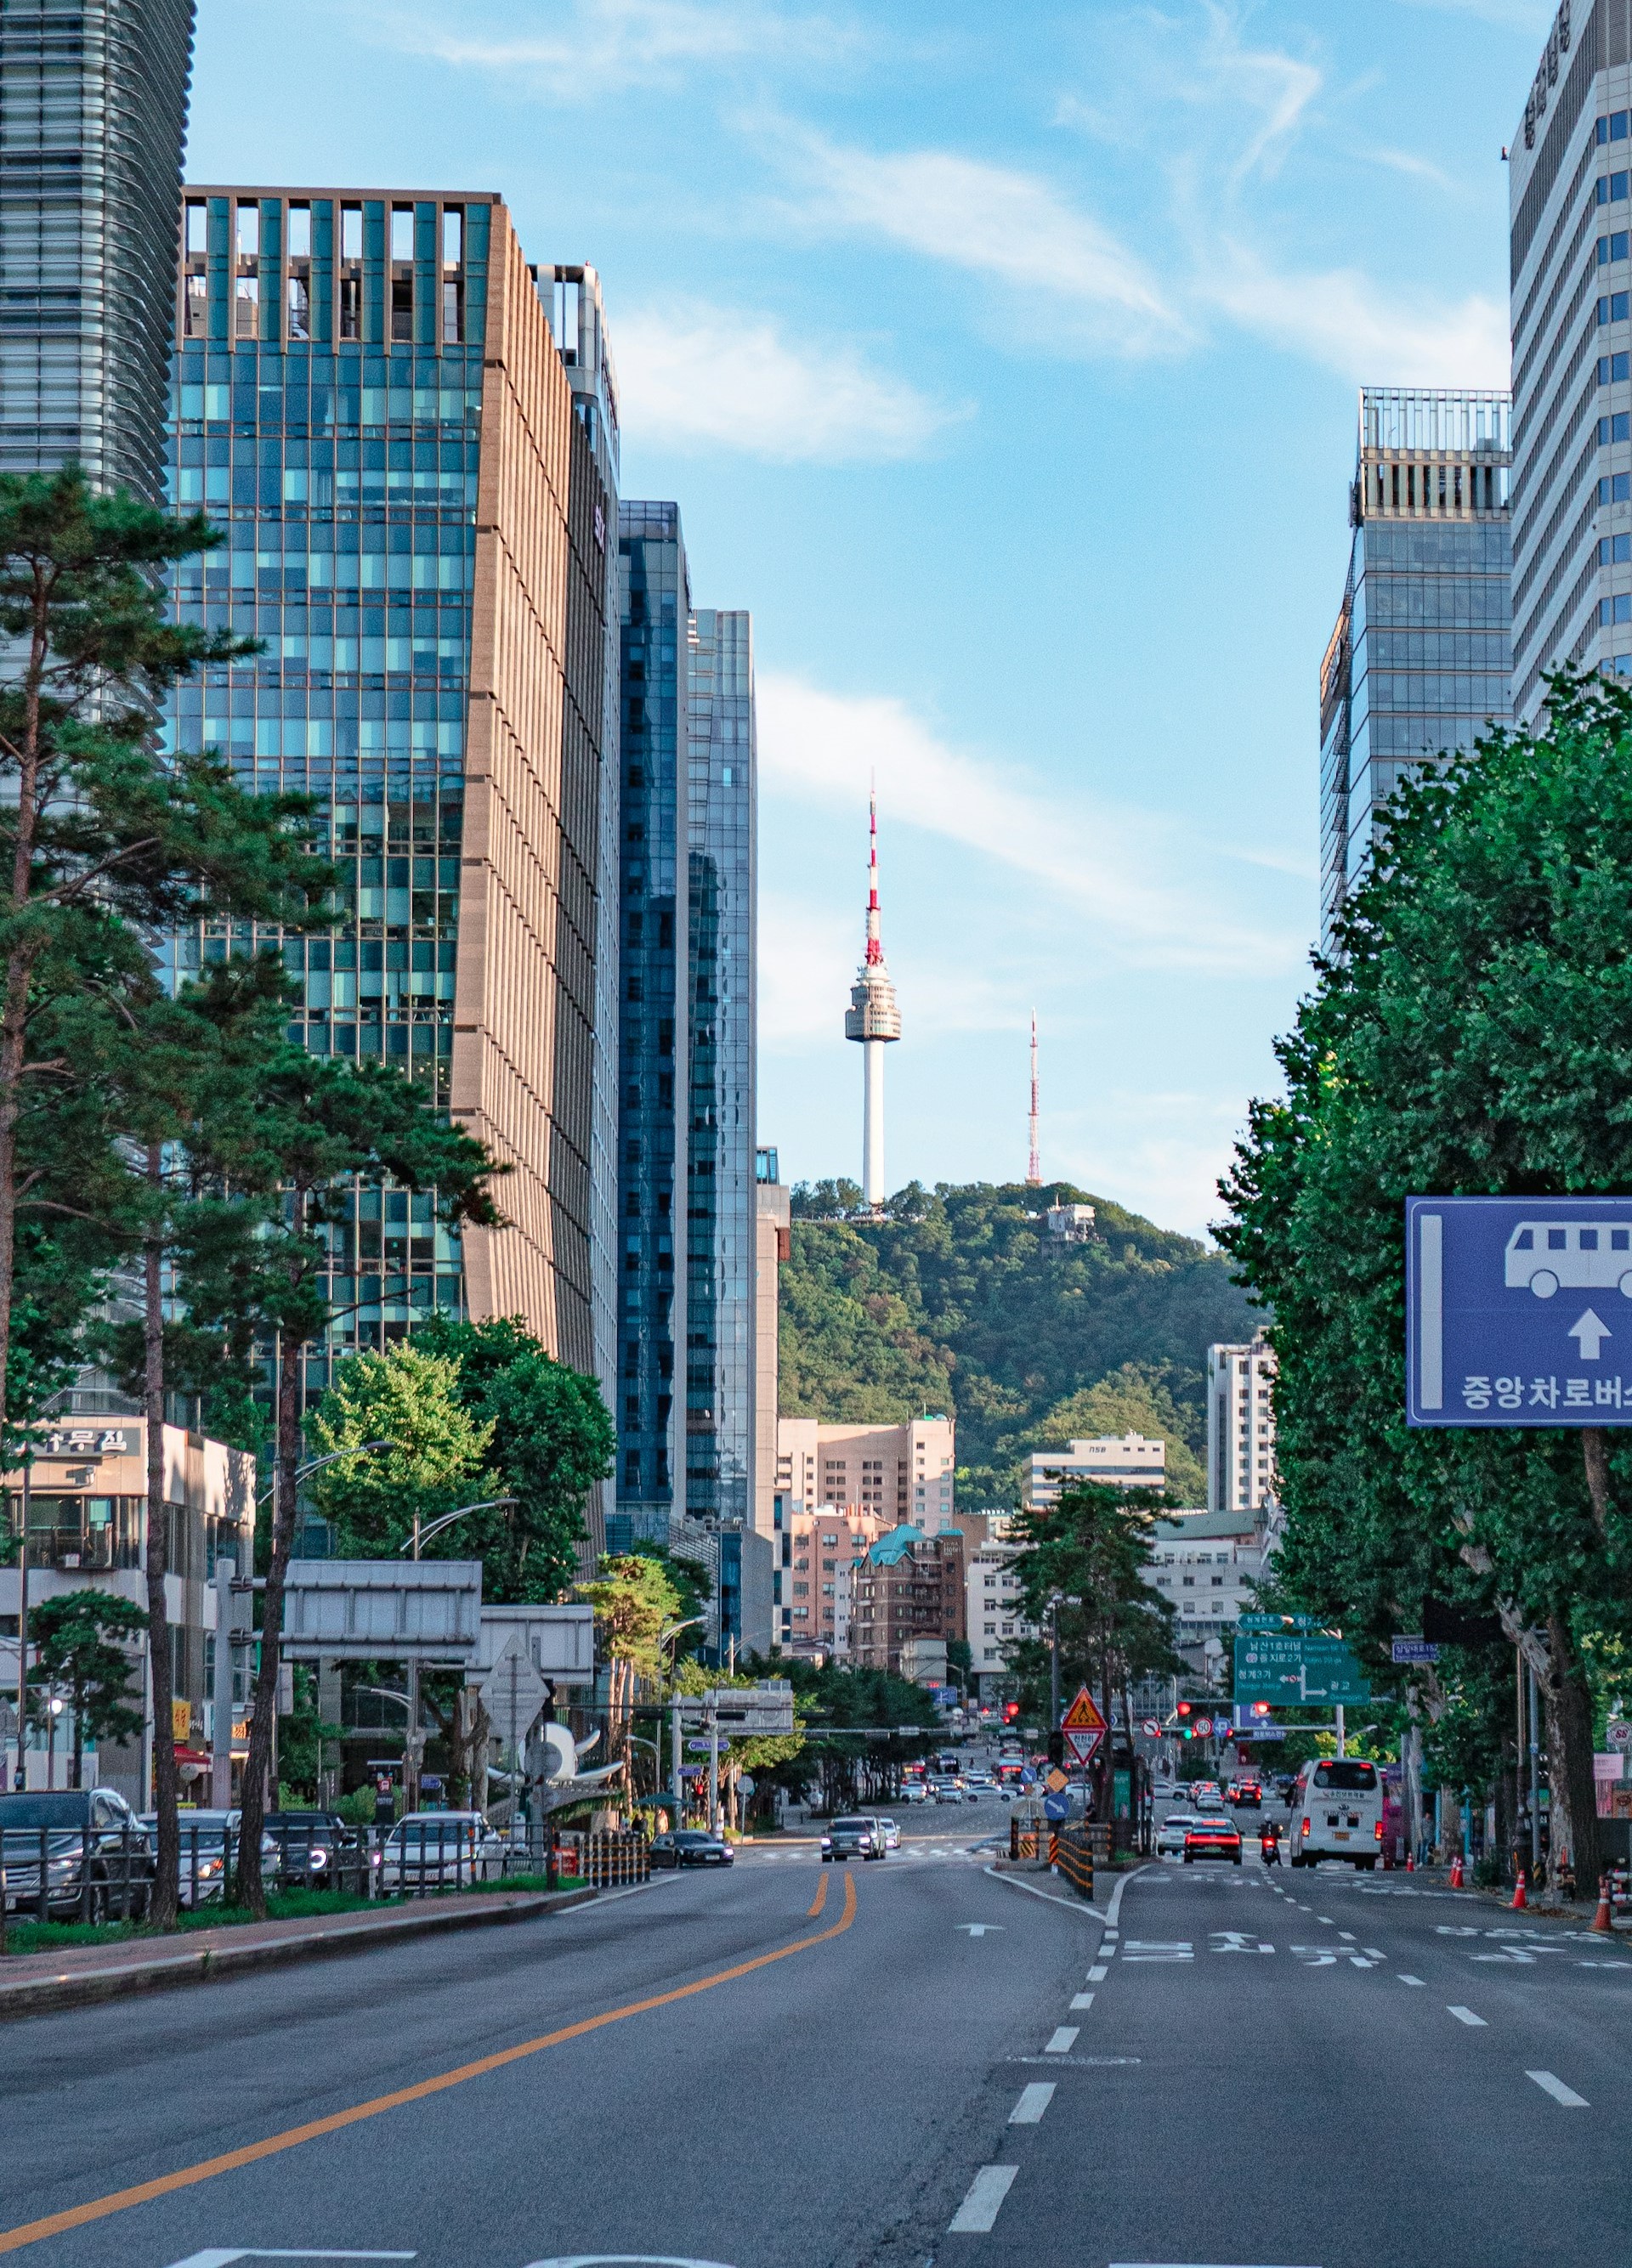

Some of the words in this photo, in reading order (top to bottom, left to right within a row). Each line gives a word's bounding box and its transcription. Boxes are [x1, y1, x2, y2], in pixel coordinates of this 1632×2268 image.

[1462, 1376, 1632, 1410] 중앙차로버
[1260, 1653, 1301, 1663] 을지로2가
[1238, 1670, 1271, 1680] 청계3가
[1198, 1722, 1209, 1732] 50
[1074, 1734, 1094, 1743] 천천히
